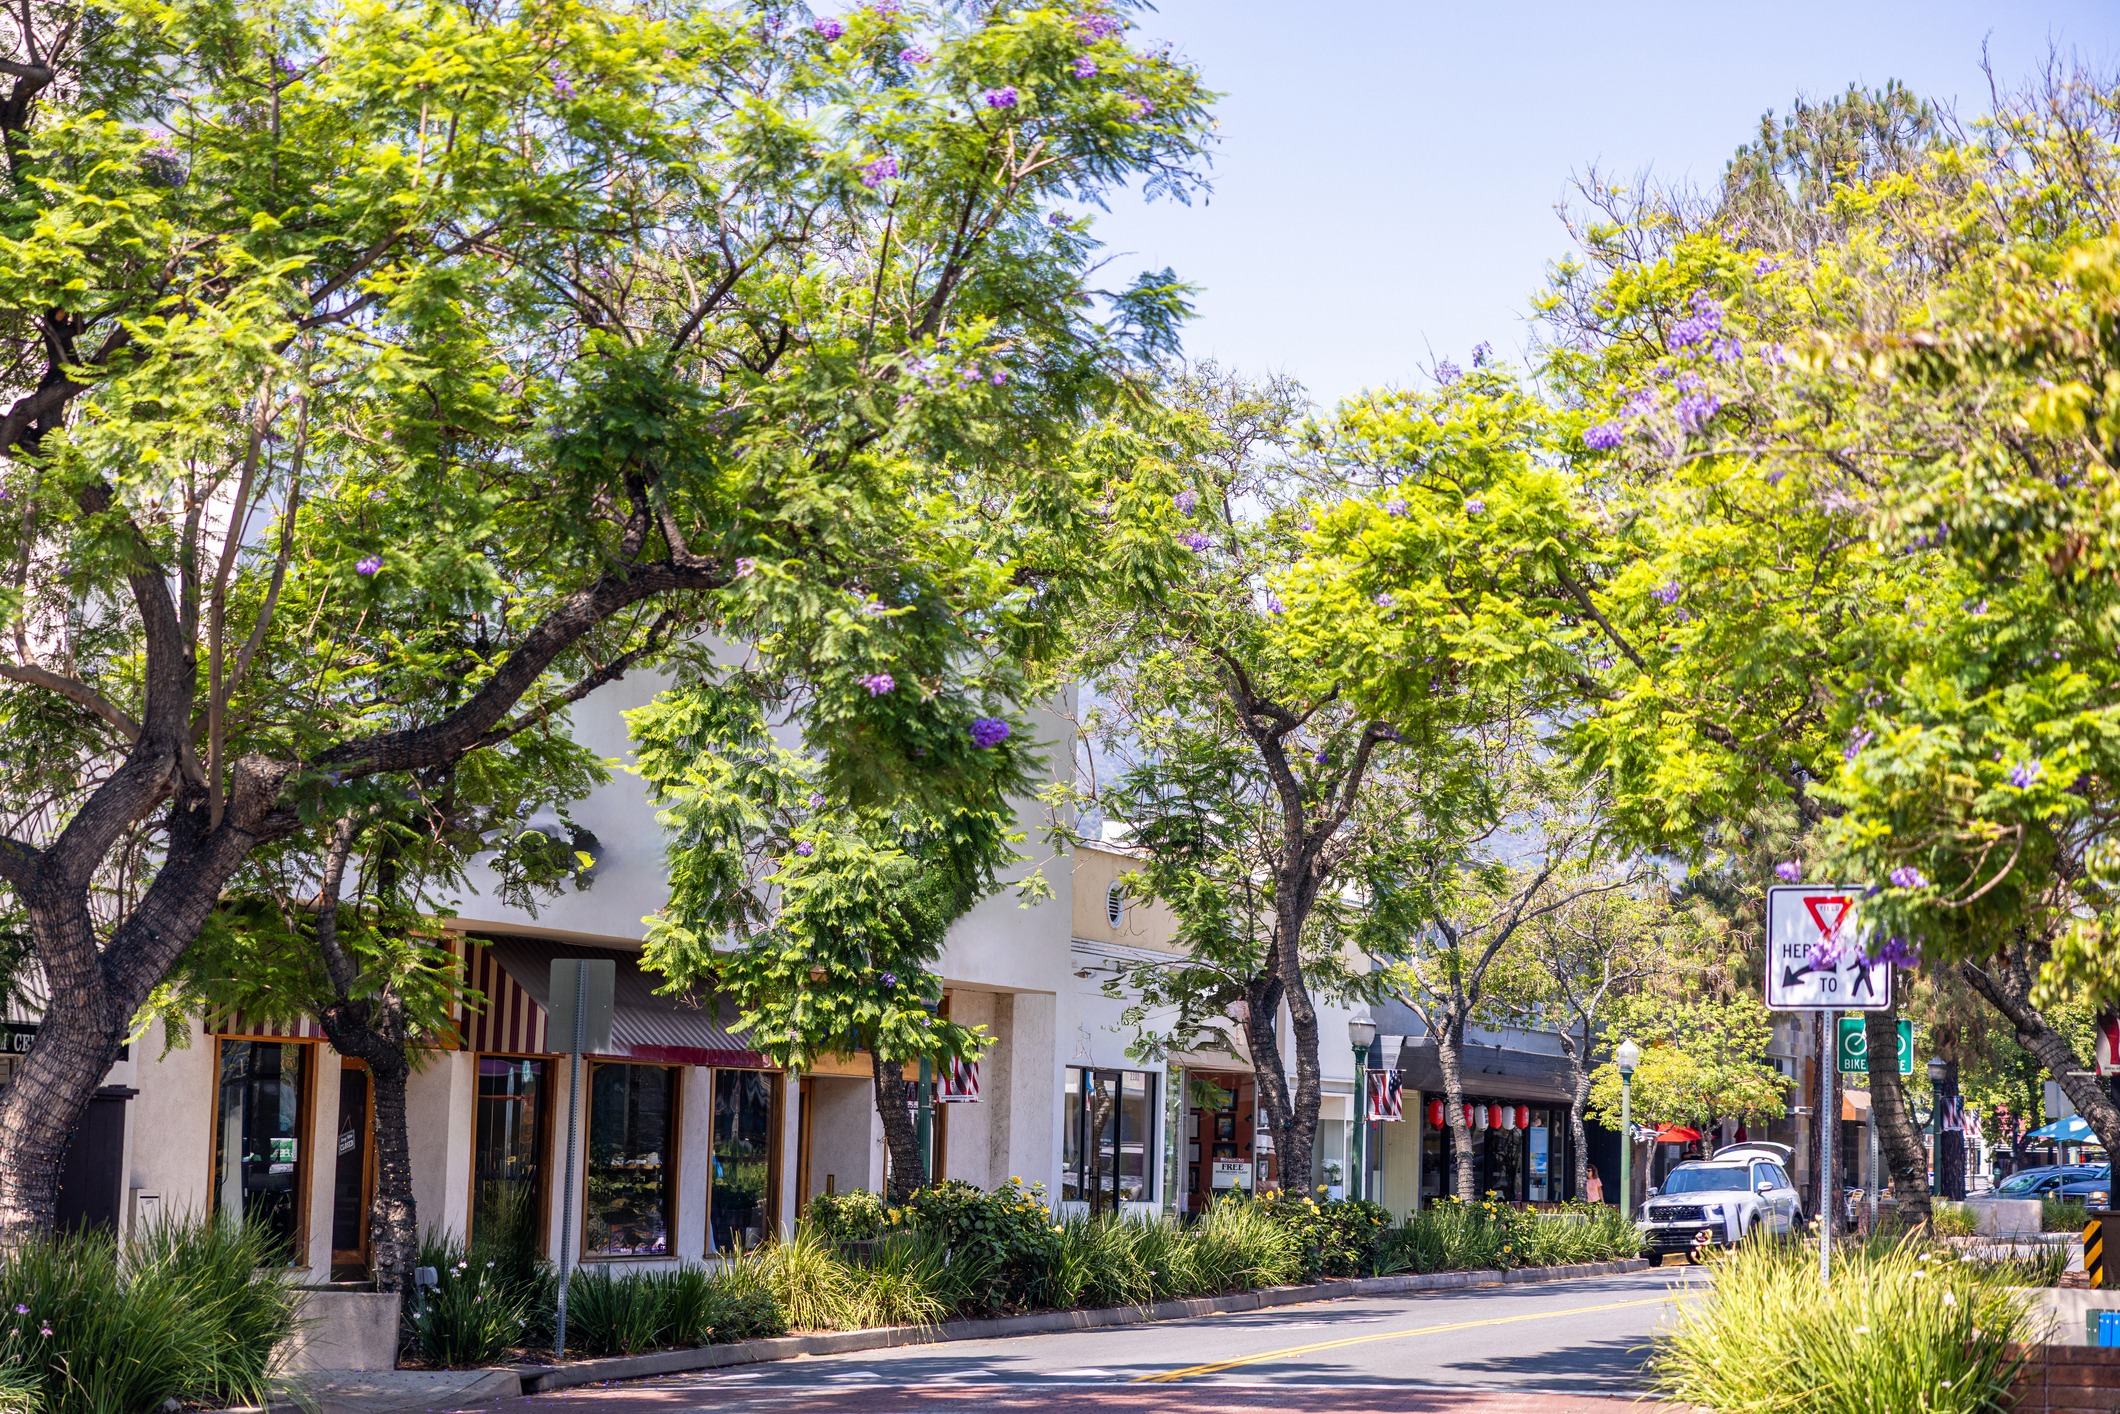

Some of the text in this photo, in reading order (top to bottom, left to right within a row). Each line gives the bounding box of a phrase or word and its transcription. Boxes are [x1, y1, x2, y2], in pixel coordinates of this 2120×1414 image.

[1820, 904, 1840, 912] YIELD
[1782, 943, 1817, 959] HER
[1819, 977, 1838, 993] TO
[1844, 1058, 1867, 1070] BIKE
[1221, 1163, 1244, 1171] FREE
